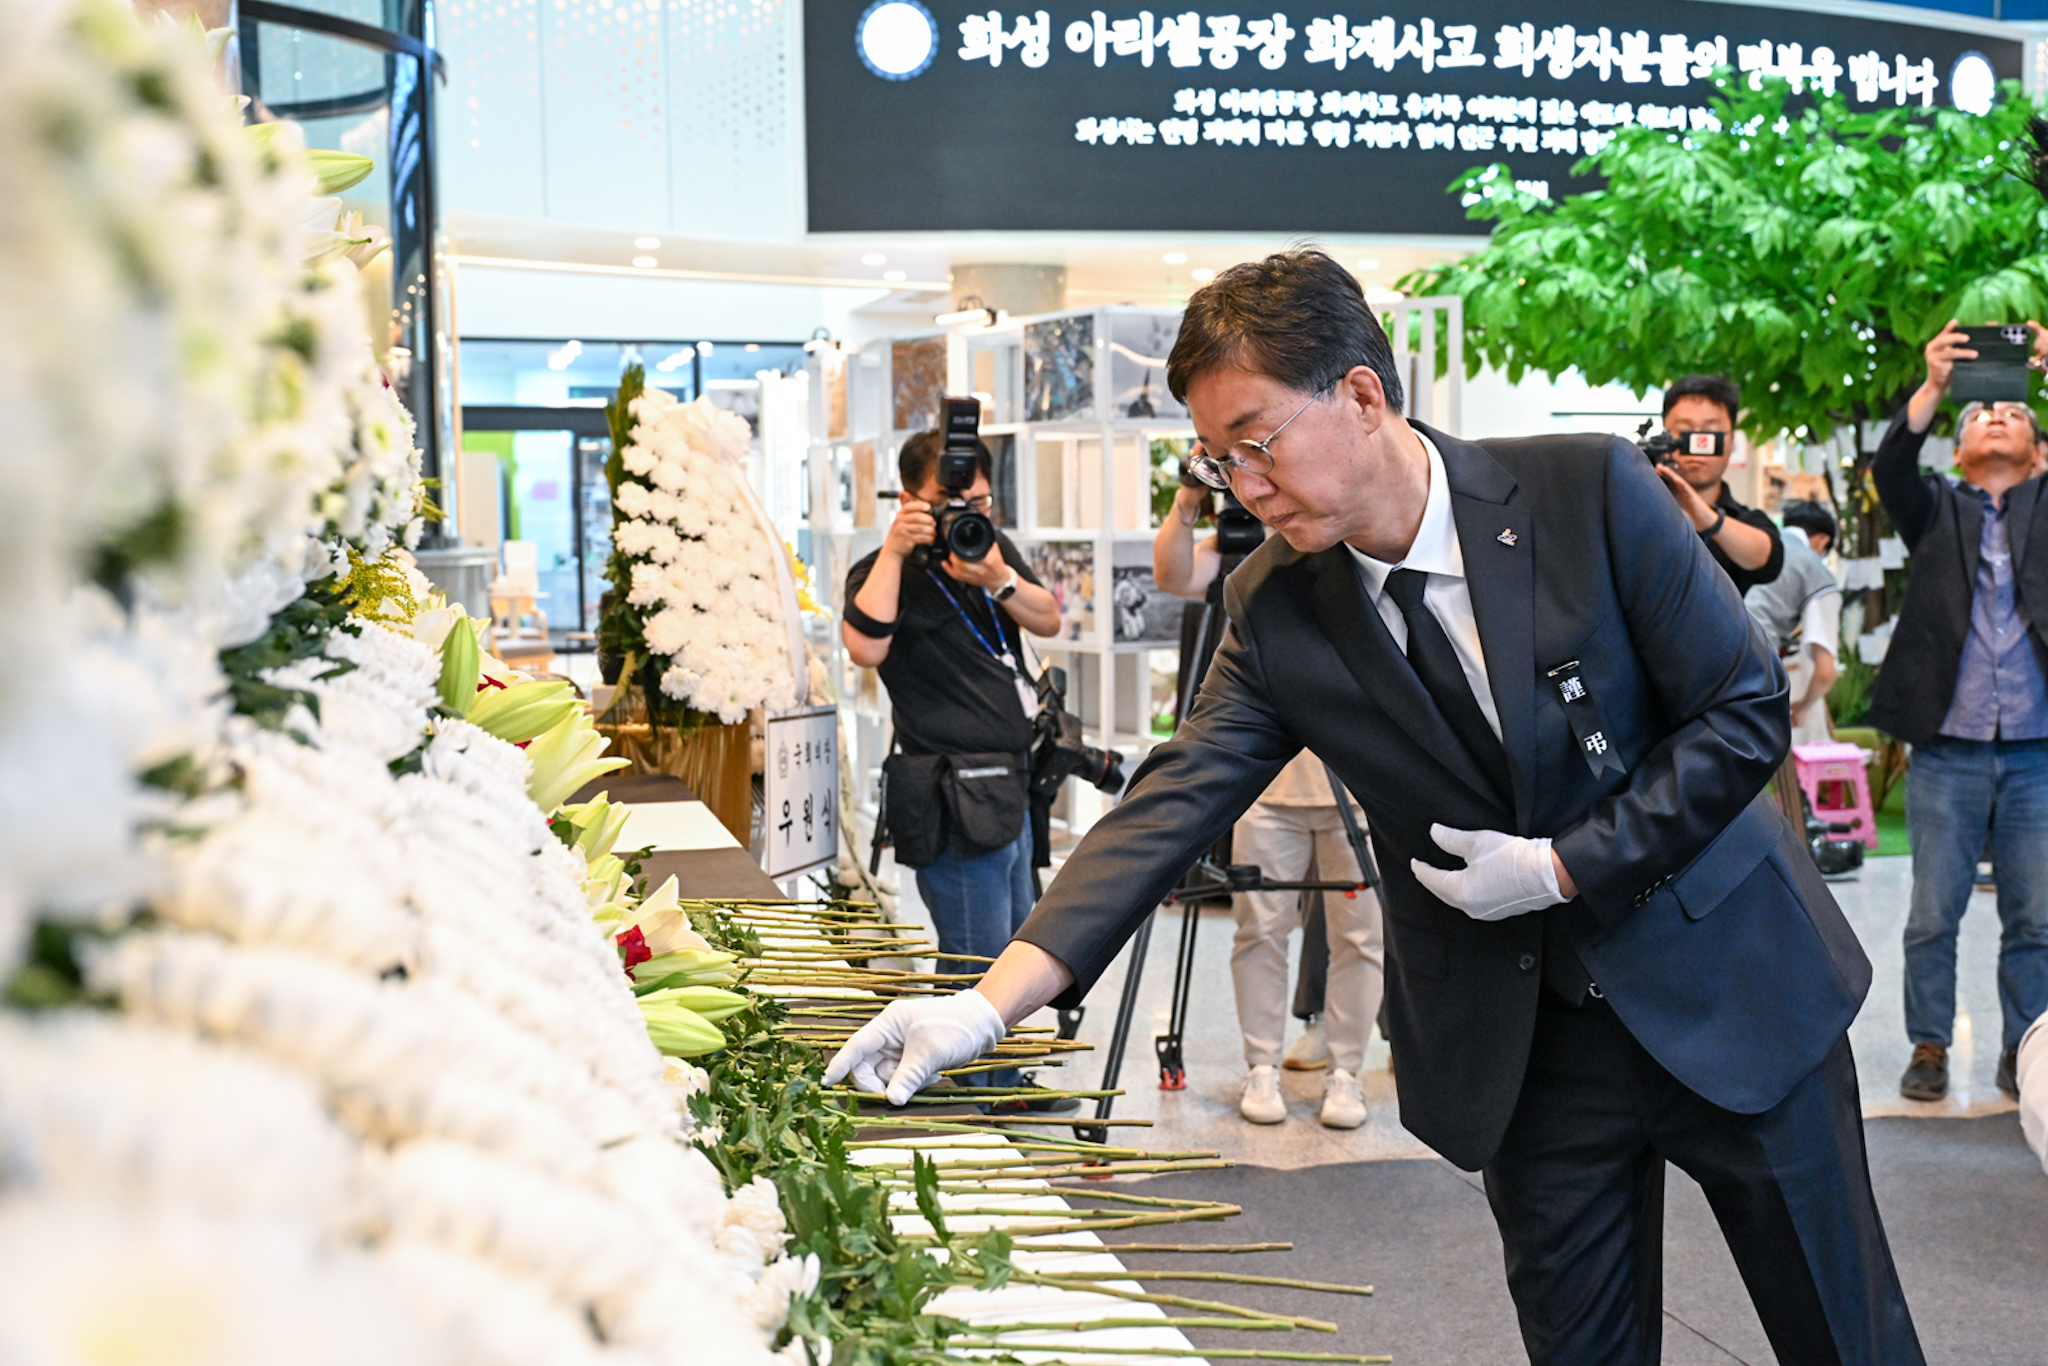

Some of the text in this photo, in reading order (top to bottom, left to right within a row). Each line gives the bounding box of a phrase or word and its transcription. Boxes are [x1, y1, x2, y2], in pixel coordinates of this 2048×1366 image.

[958, 10, 1050, 68] 화성
[1065, 10, 1296, 70] 아리셀공장
[1304, 14, 1486, 74] 화재사고
[1493, 22, 1728, 87] 희생자분들의
[1848, 50, 1939, 109] 빕니다
